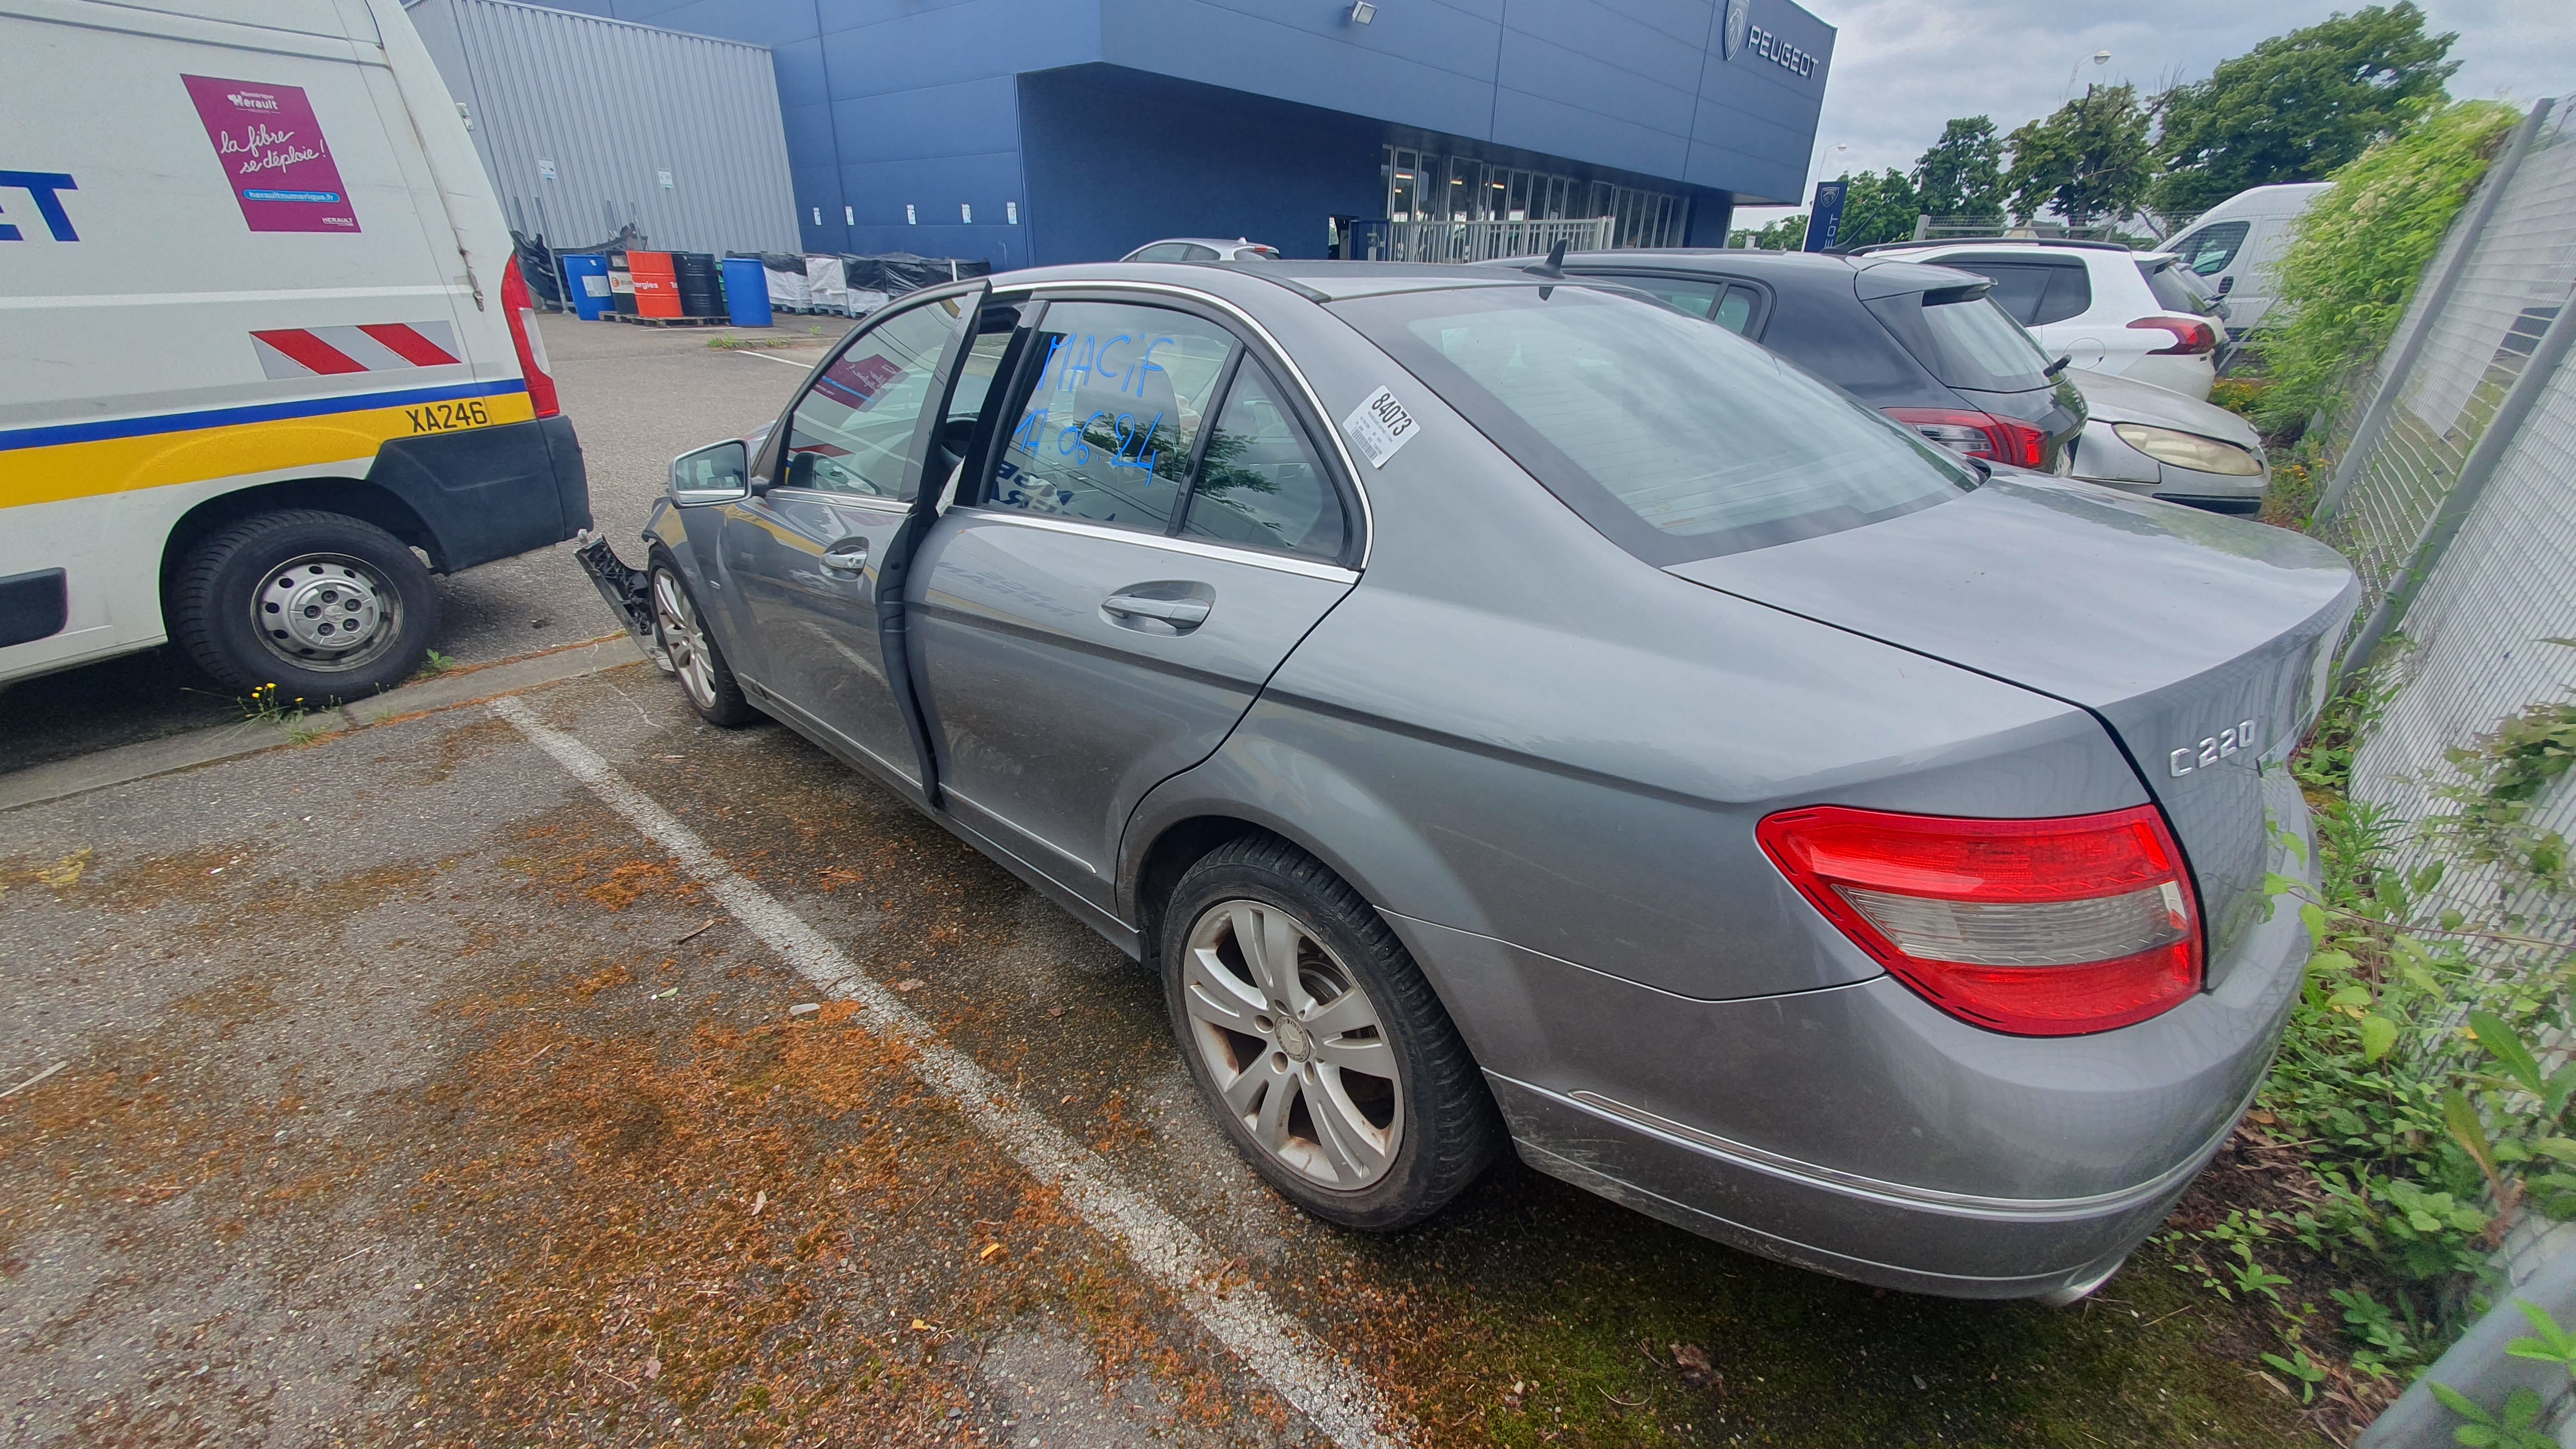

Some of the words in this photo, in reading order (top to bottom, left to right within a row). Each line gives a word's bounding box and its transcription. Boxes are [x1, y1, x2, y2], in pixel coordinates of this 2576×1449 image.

[1748, 24, 1819, 80] PEUGEOT
[220, 130, 245, 154] la
[244, 123, 295, 158] fibre
[239, 160, 262, 174] se
[405, 401, 488, 433] XA246
[1371, 392, 1413, 437] 84073
[2170, 747, 2193, 778] C
[2197, 719, 2255, 769] 220
